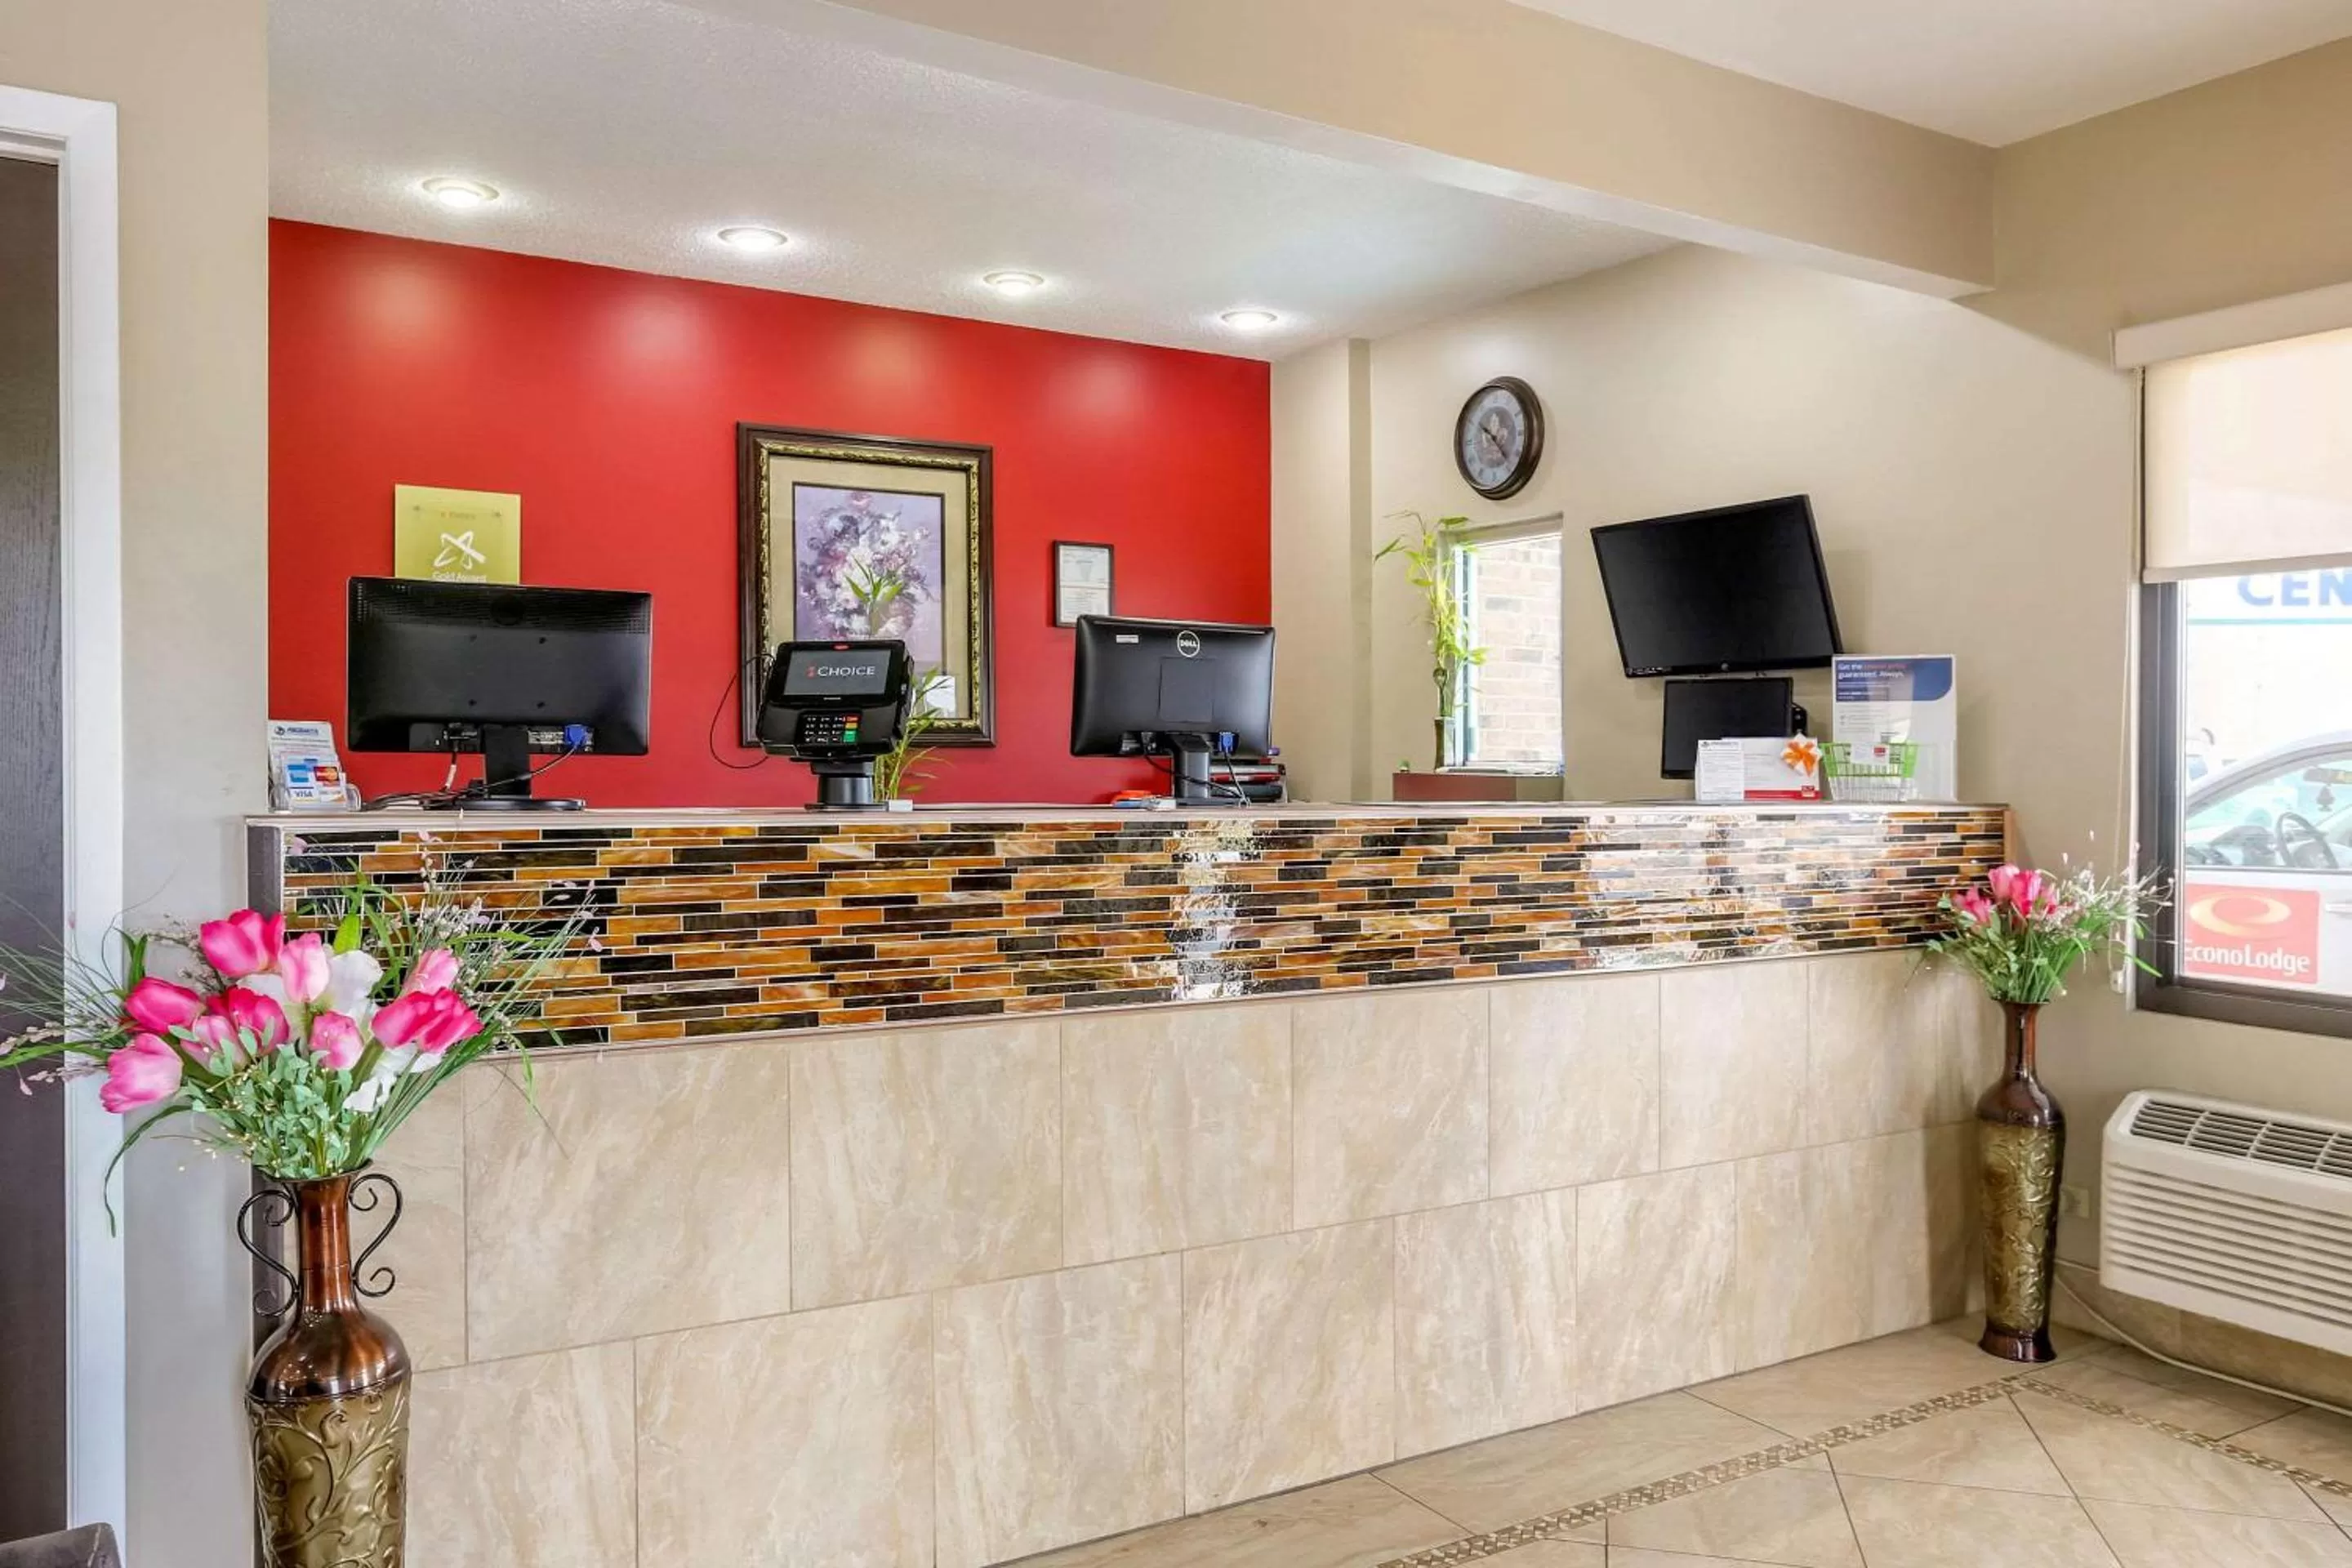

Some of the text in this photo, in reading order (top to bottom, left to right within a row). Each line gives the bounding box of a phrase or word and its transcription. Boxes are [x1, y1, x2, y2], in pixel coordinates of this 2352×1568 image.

[1180, 639, 1198, 648] DELL
[817, 666, 876, 676] CHOICE
[295, 790, 314, 798] VISA
